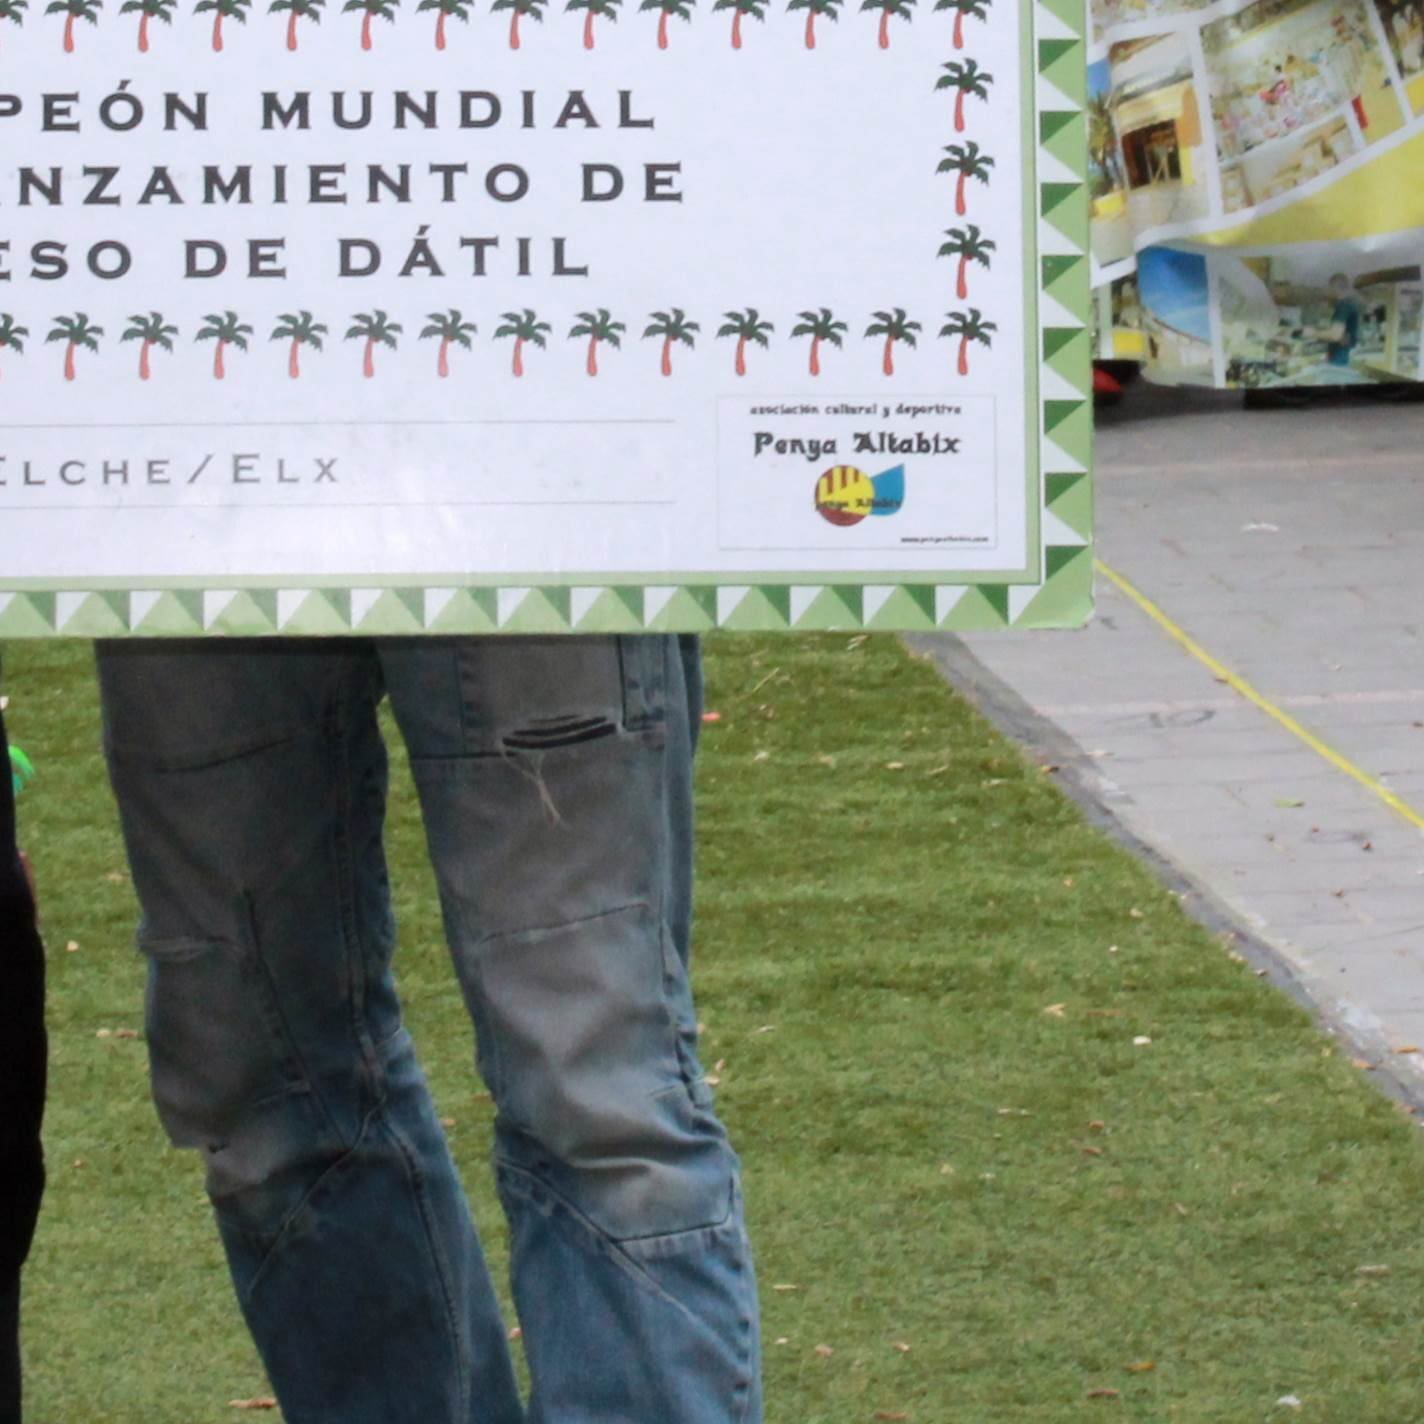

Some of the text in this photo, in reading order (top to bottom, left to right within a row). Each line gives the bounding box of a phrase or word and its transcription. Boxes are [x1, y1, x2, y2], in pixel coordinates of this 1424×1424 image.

[261, 88, 656, 132] MUNDIAL
[581, 161, 684, 204] DE
[183, 236, 288, 280] DE
[337, 223, 590, 279] DÁTIL
[895, 403, 962, 419] deportiva
[752, 431, 962, 463] Penya Altabix
